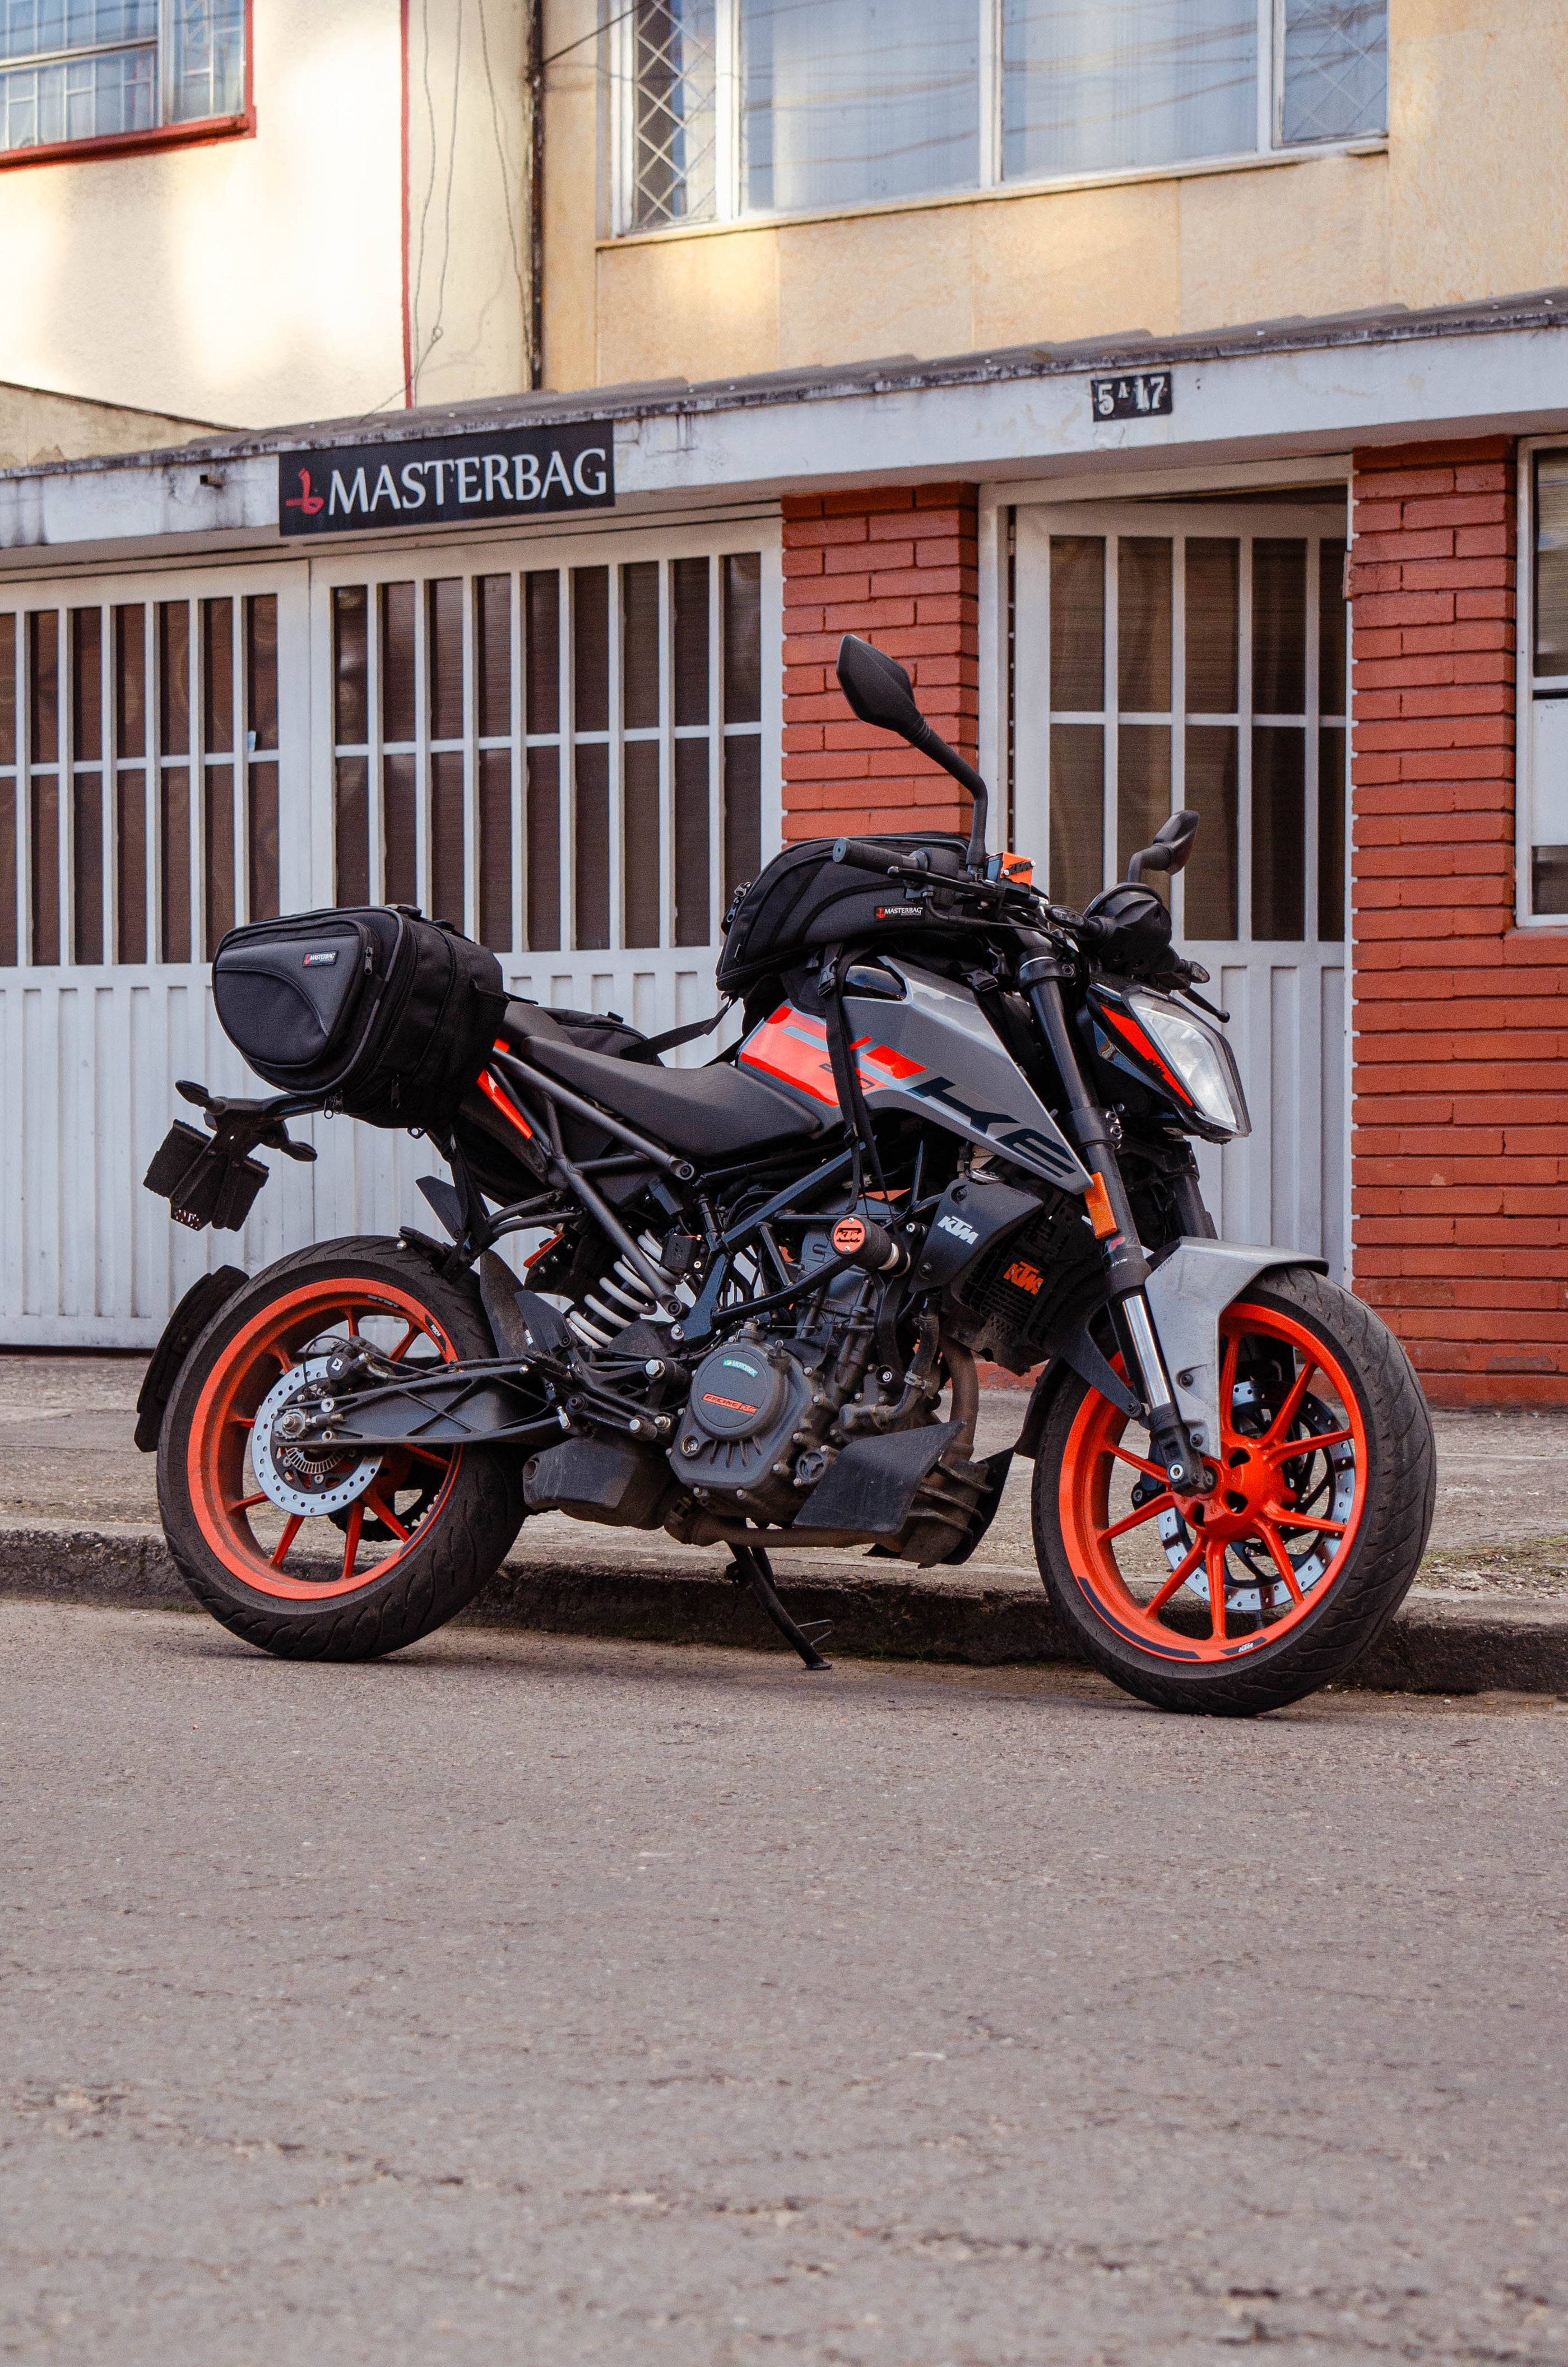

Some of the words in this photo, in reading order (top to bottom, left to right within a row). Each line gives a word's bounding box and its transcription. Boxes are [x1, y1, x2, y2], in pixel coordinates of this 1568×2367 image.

[328, 448, 607, 516] MASTERBAG
[836, 1227, 862, 1242] KTM
[937, 1215, 979, 1245] KTM
[1003, 1260, 1044, 1296] KTM
